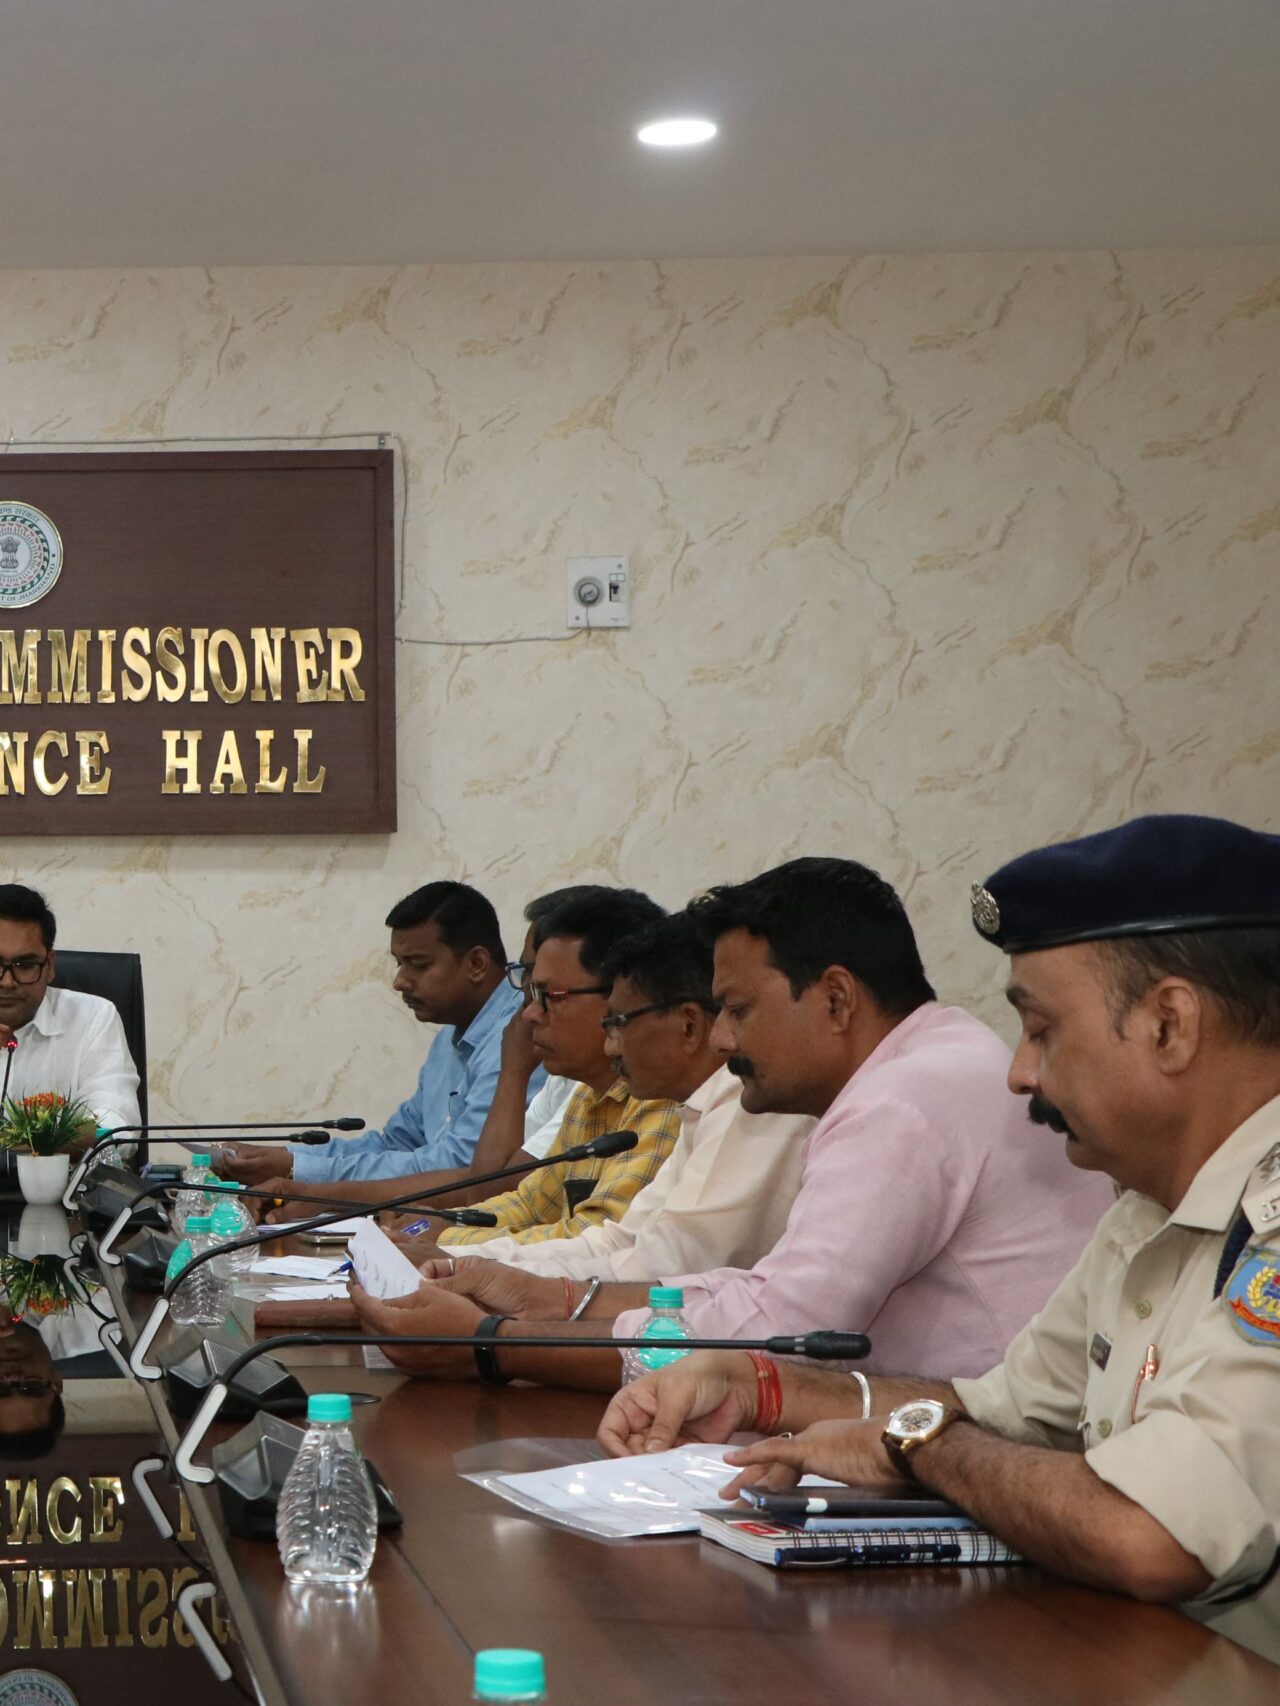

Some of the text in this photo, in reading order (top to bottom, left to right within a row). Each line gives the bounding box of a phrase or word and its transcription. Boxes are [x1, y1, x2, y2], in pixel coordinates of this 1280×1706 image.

[6, 593, 17, 601] OF
[19, 562, 56, 601] JHARKHAND
[161, 729, 326, 794] HALL
